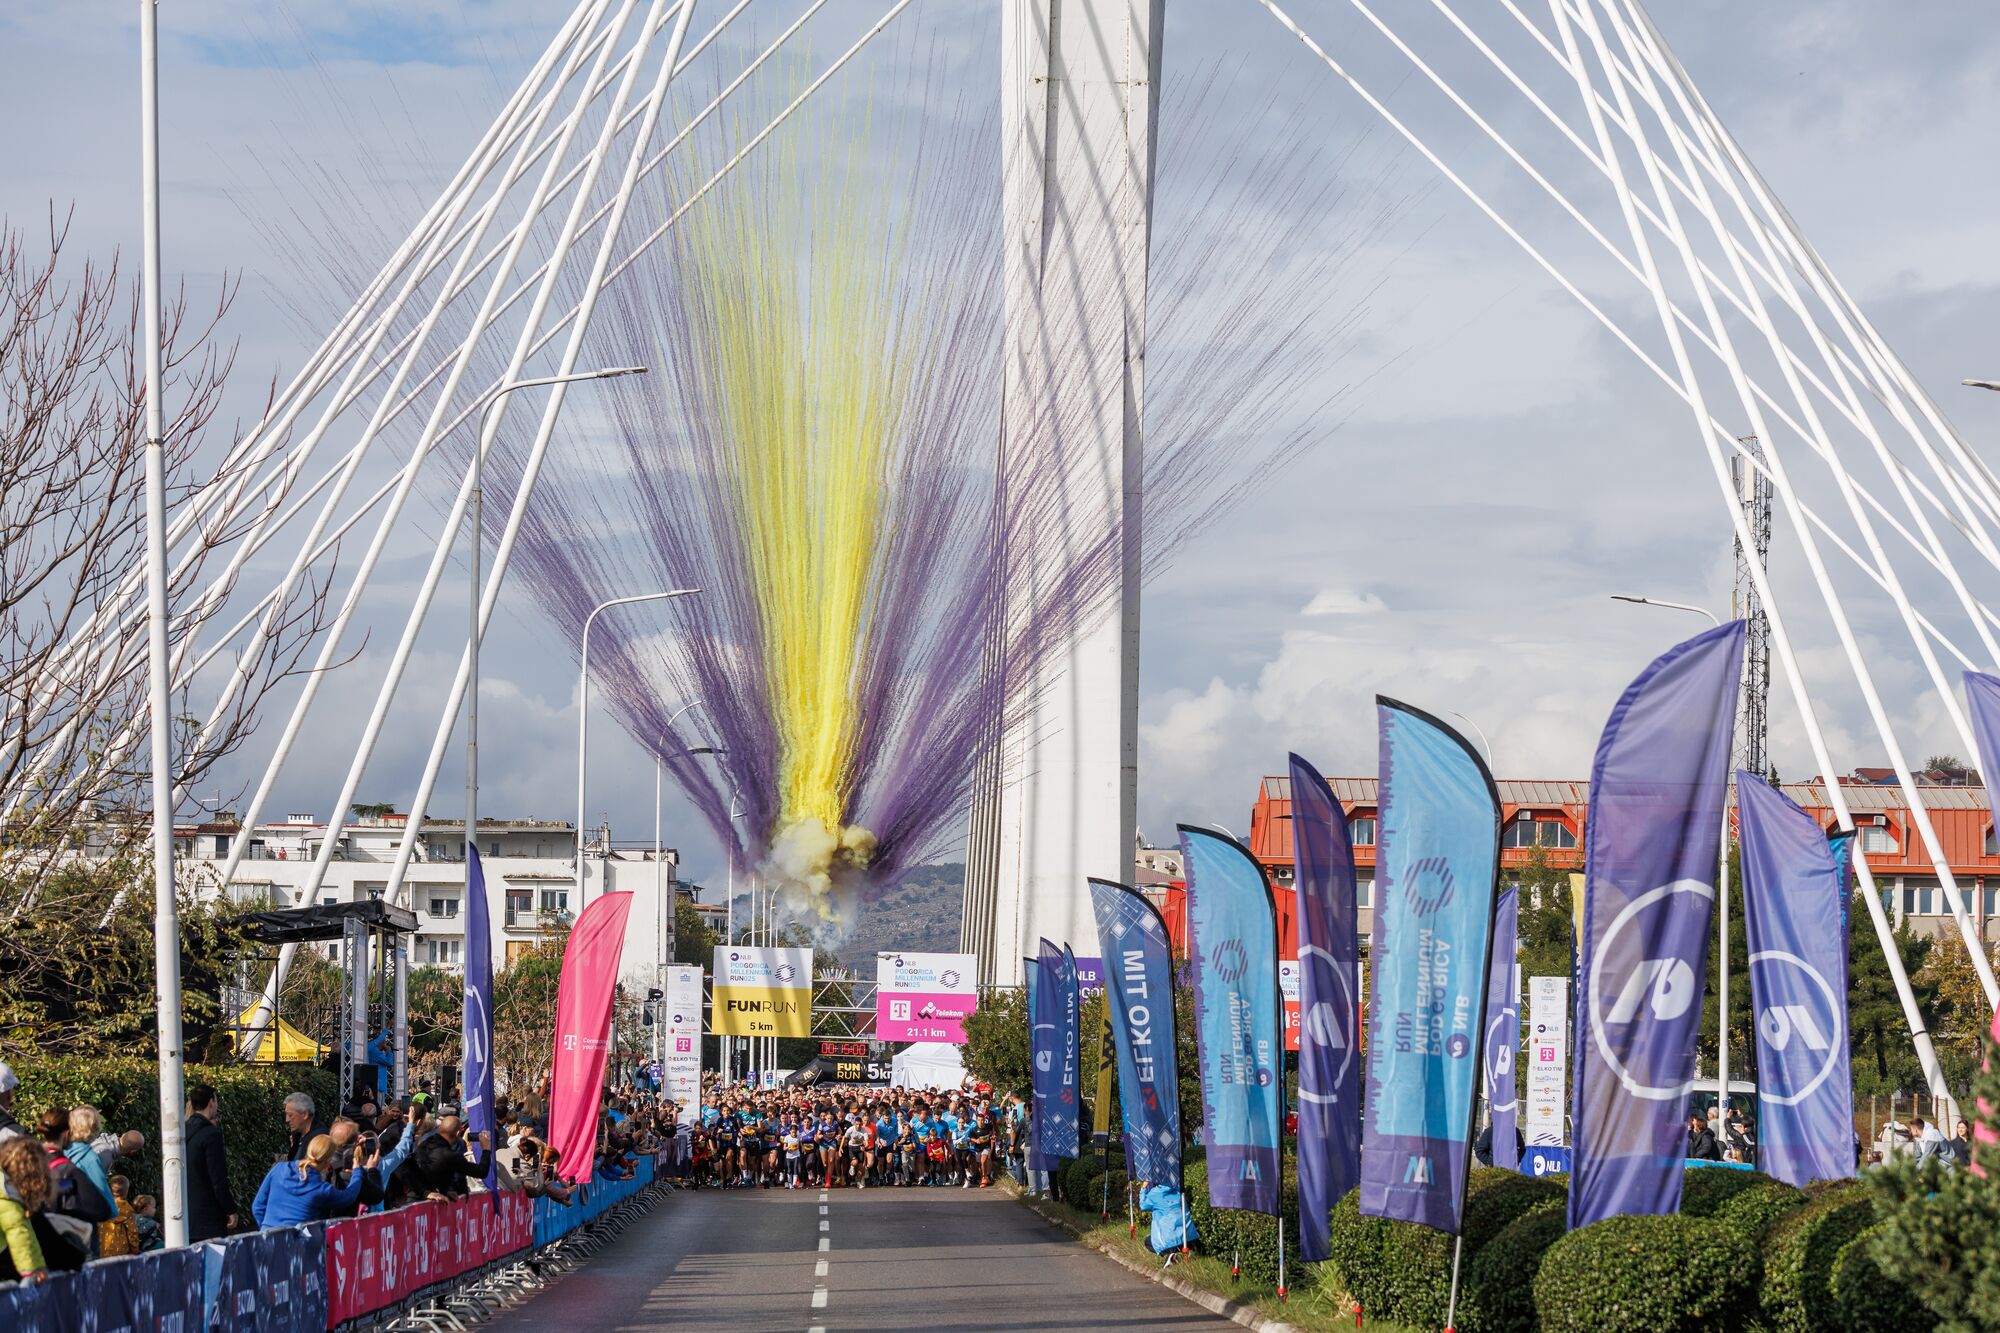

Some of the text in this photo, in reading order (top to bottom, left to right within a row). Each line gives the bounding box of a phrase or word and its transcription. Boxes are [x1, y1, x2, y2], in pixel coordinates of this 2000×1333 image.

[727, 1000, 797, 1013] FUNRUN
[750, 1022, 773, 1031] 5 km
[907, 1027, 946, 1037] 21.1 km
[837, 1062, 860, 1071] FUN
[837, 1071, 860, 1080] RUN
[1546, 1160, 1561, 1173] NLB
